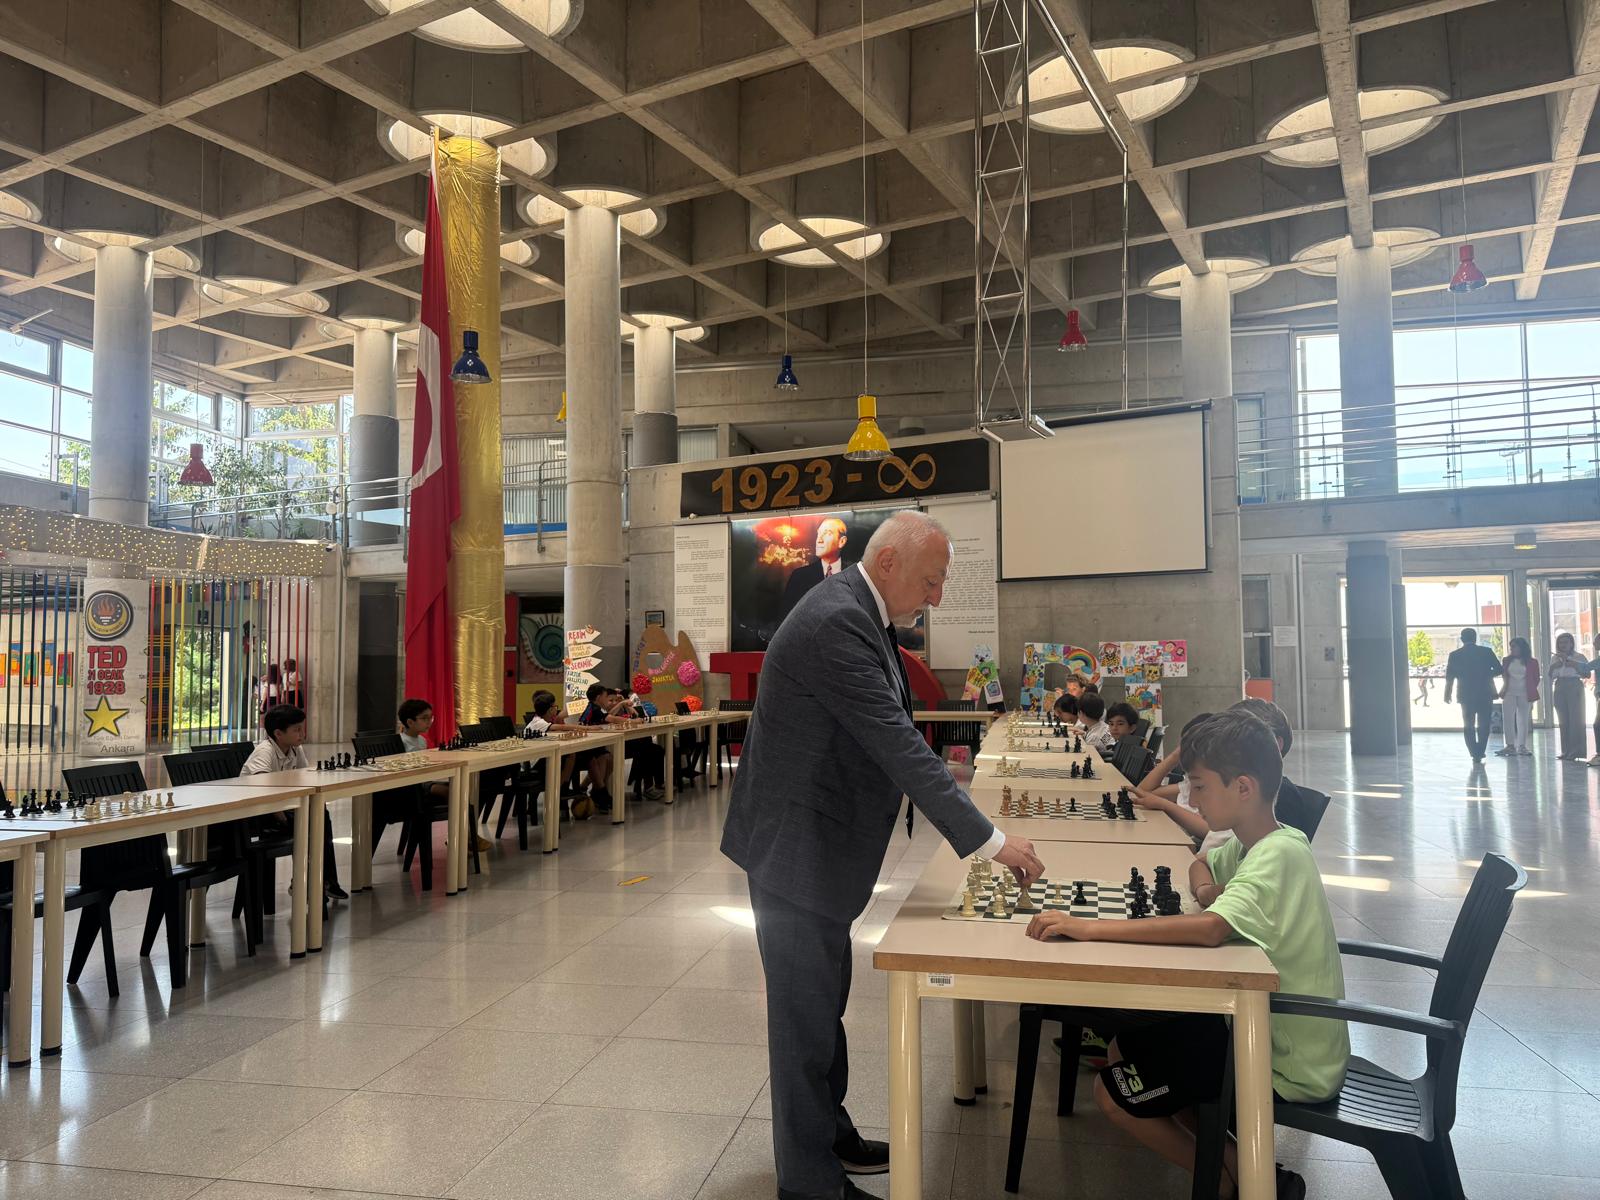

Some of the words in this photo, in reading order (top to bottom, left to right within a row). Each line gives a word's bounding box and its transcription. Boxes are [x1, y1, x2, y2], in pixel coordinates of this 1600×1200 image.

[711, 459, 834, 513] 1923
[87, 645, 128, 669] TED
[87, 681, 126, 695] 1928
[1122, 1063, 1144, 1093] 73
